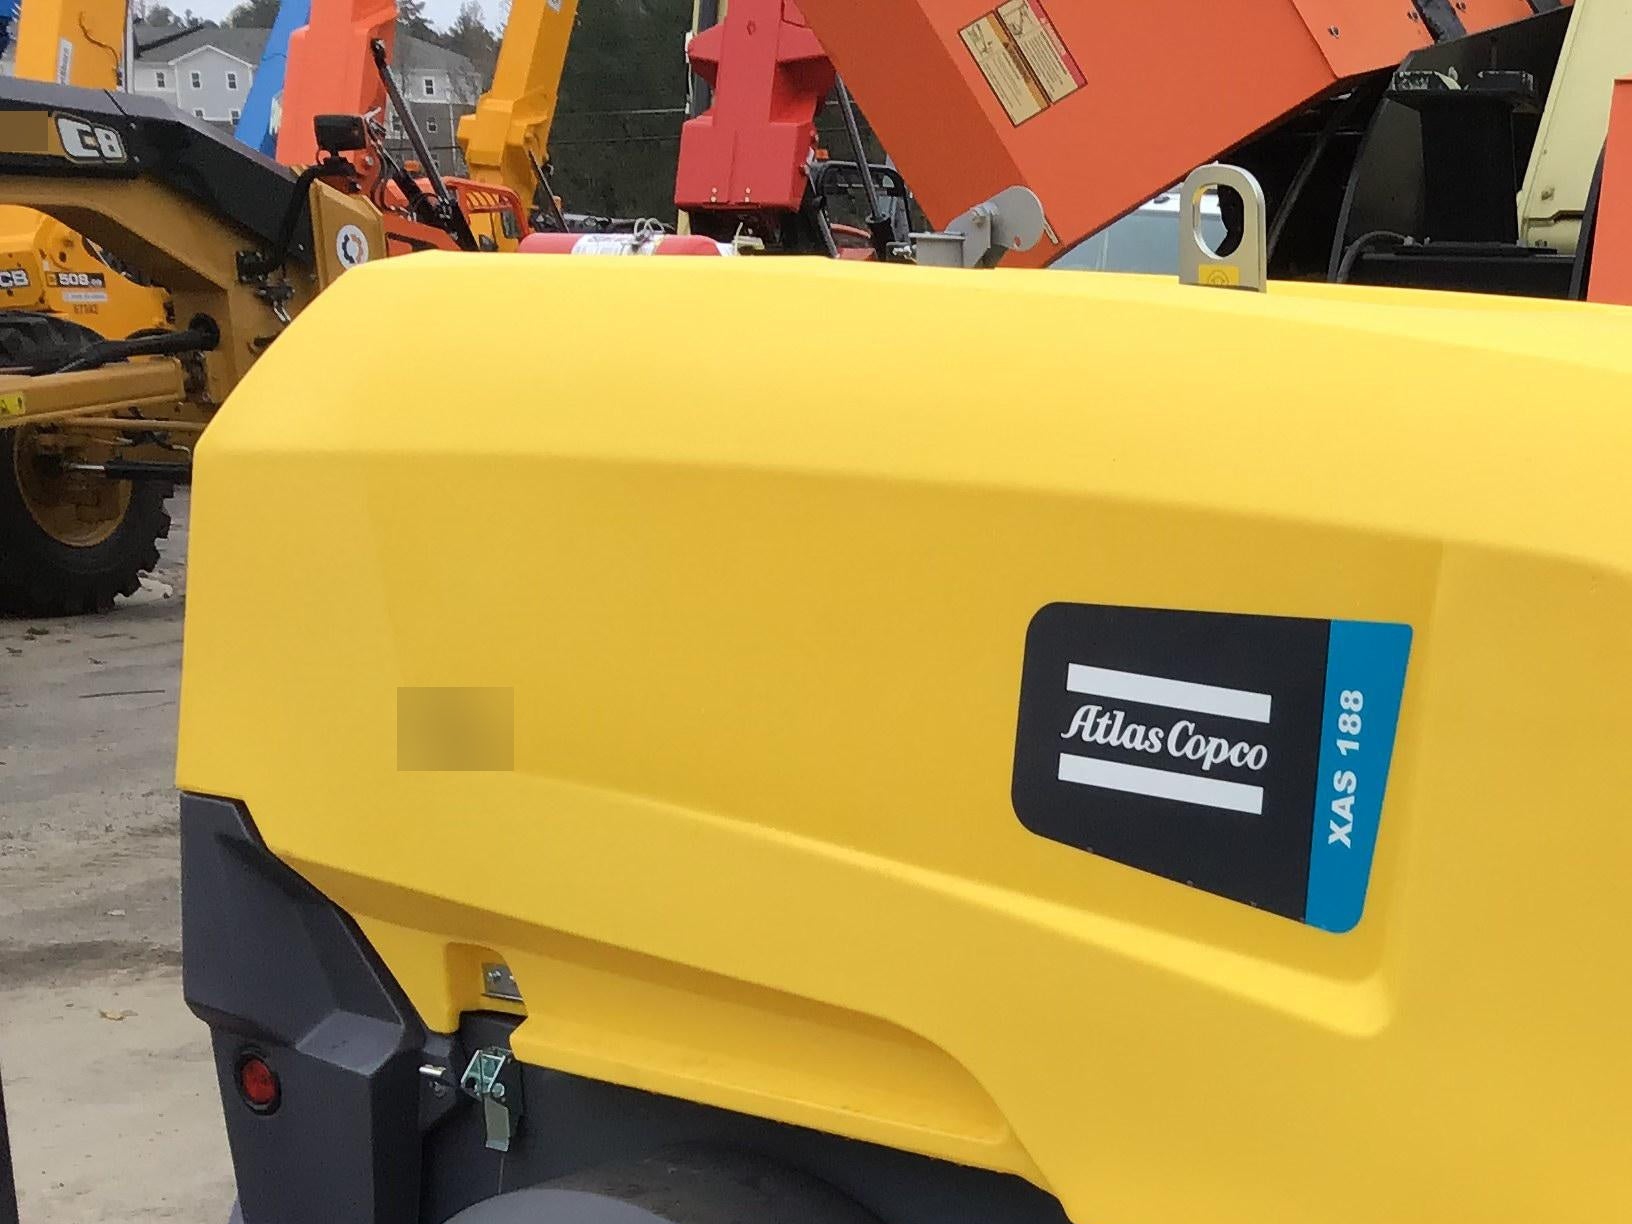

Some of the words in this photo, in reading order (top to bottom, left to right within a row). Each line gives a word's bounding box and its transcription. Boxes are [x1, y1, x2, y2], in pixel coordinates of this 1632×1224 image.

[1061, 704, 1164, 754] Atlas
[1167, 720, 1268, 770] Copco
[1336, 690, 1364, 757] 188
[1328, 770, 1358, 848] XAS
